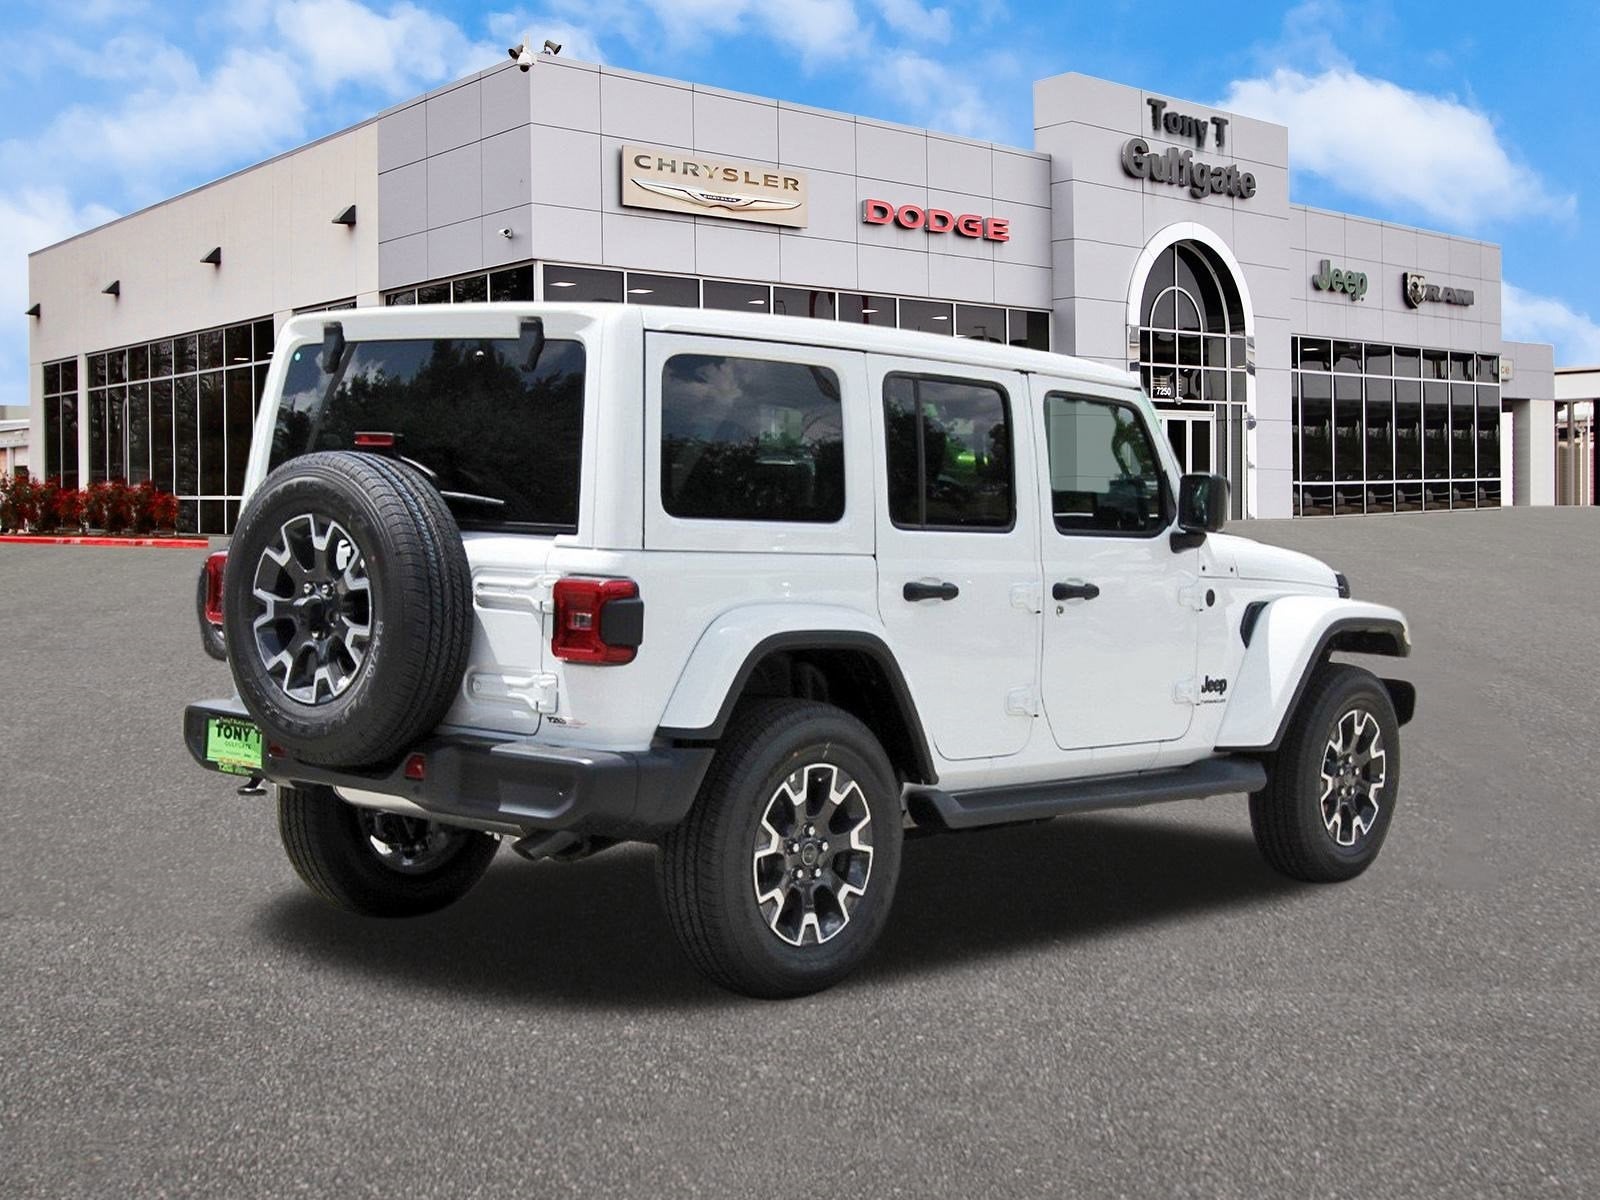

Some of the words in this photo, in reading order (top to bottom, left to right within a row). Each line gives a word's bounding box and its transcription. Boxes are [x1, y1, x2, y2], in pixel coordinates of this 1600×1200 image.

[1147, 97, 1208, 148] Tony
[1210, 116, 1229, 147] T
[633, 153, 801, 192] CHRYSLER
[1121, 137, 1257, 199] Gulfgate
[862, 198, 1010, 242] DODGE
[1312, 259, 1368, 302] Jeep
[1424, 283, 1475, 307] RAM
[1156, 386, 1172, 396] 7250
[1200, 674, 1227, 696] Jeep
[216, 723, 252, 742] TONY
[254, 728, 262, 744] T
